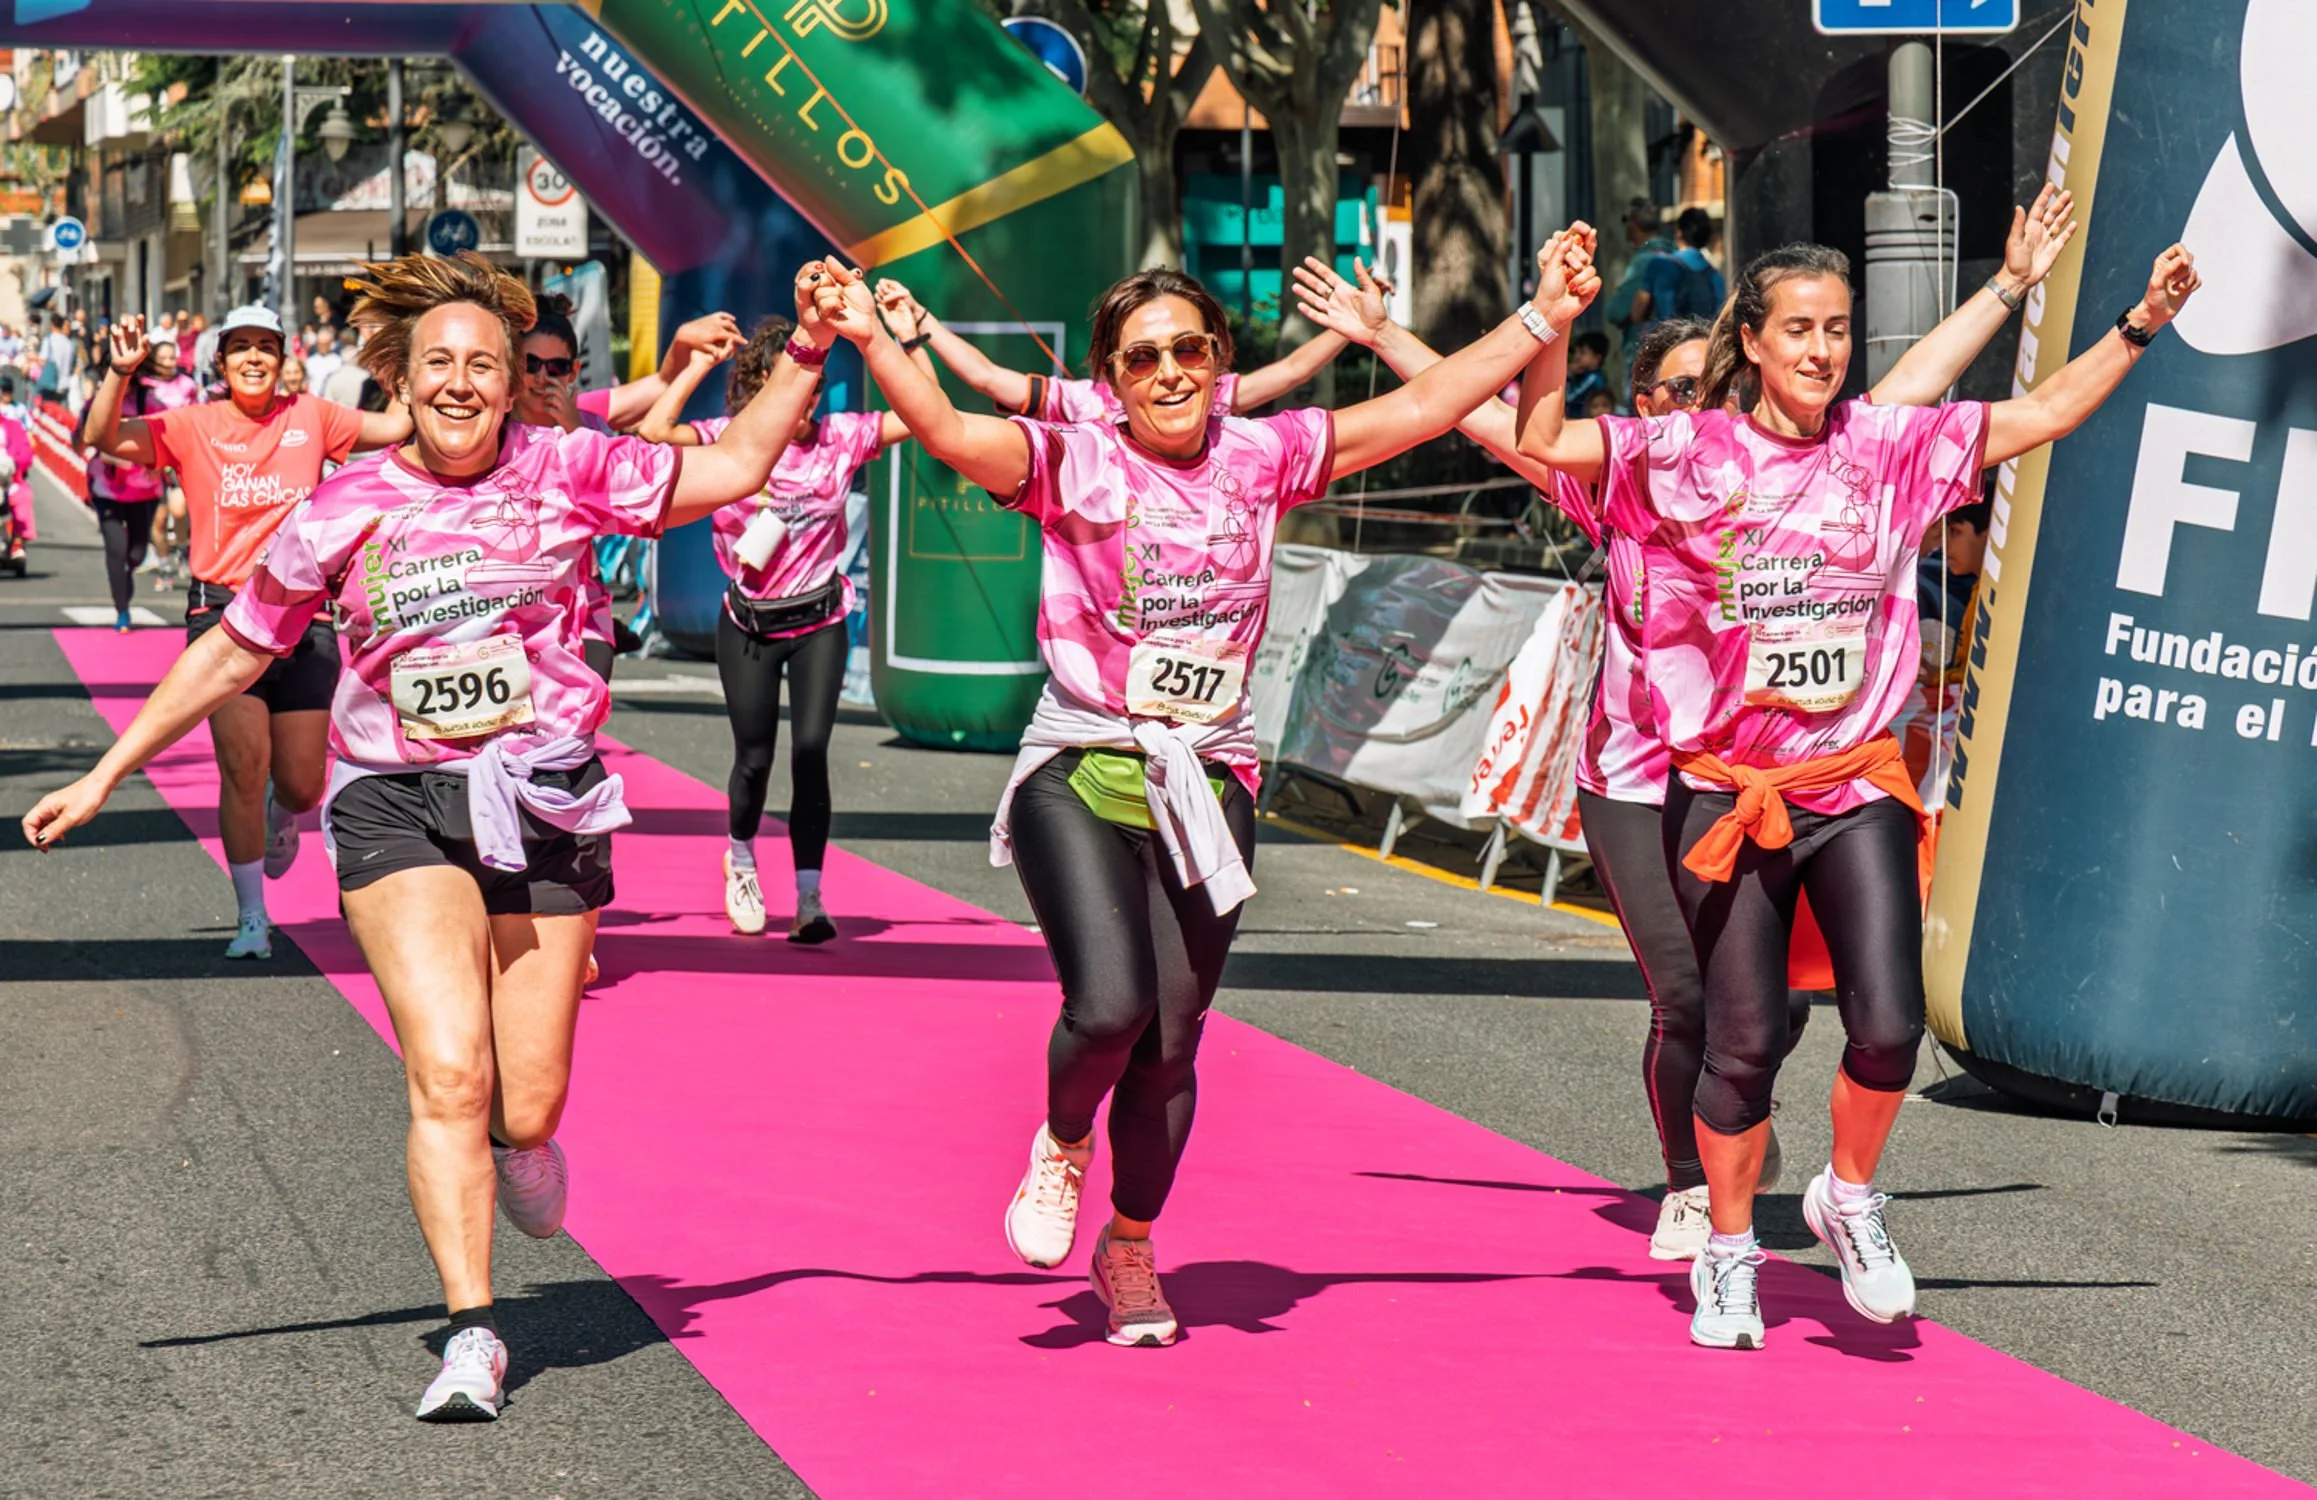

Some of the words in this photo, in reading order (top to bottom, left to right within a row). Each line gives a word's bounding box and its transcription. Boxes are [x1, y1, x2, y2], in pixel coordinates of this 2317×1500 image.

[579, 32, 708, 161] nuestra
[556, 50, 681, 186] vocación.
[537, 171, 567, 190] 30
[222, 463, 256, 478] HOY
[222, 475, 280, 492] GANAN
[221, 491, 249, 507] LAS
[387, 535, 407, 557] XI
[1743, 528, 1764, 546] XI
[388, 548, 482, 580] Carrera
[1141, 543, 1161, 562] XI
[1740, 553, 1823, 571] Carrera
[1141, 567, 1215, 588] Carrera
[1740, 580, 1778, 602] por
[1783, 577, 1803, 595] la
[392, 584, 431, 612] por
[438, 577, 461, 595] la
[1141, 597, 1176, 616] por
[1180, 594, 1200, 610] la
[398, 586, 544, 629] Investigación
[1140, 603, 1261, 631] Investigación
[1742, 595, 1876, 621] Investigación
[1765, 647, 1845, 687] 2501
[412, 667, 510, 715] 2596
[1152, 657, 1226, 703] 2517
[2094, 677, 2207, 730] para
[2235, 698, 2286, 742] el
